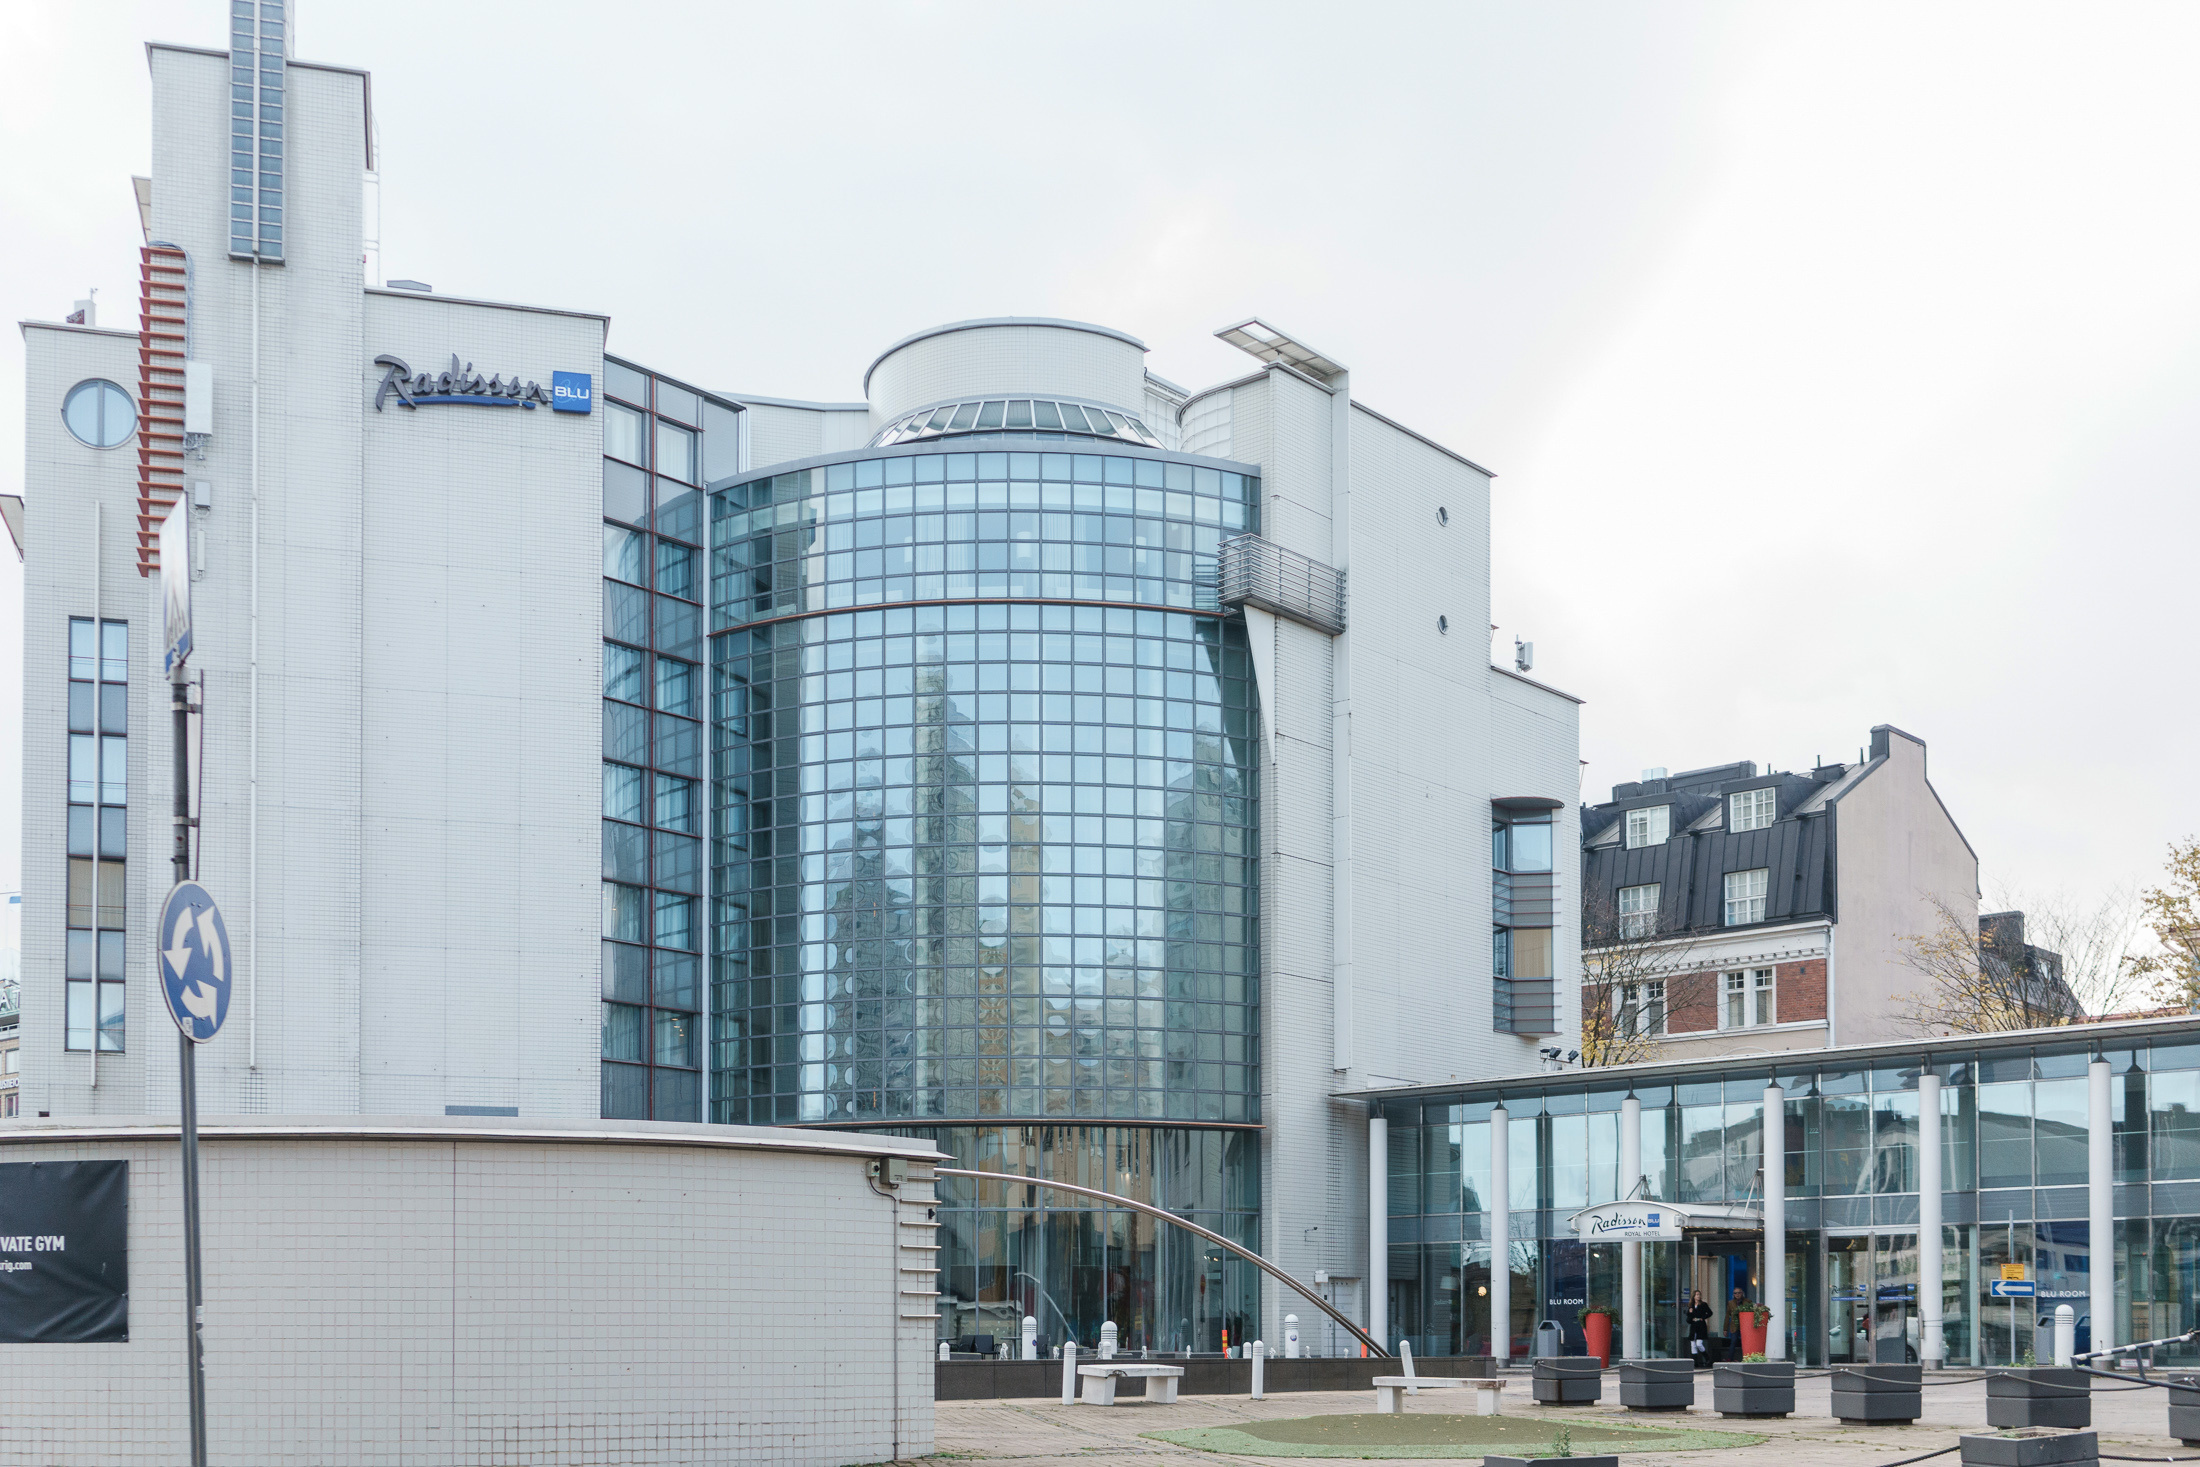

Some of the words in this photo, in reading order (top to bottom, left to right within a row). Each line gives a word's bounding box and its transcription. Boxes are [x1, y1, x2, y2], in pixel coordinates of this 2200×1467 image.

[374, 352, 549, 412] Radisson
[554, 385, 590, 400] BLU
[1591, 1212, 1646, 1235] Radisson
[35, 1235, 65, 1251] GYM
[0, 1259, 33, 1273] rig.com
[2040, 1290, 2057, 1298] BLU
[2059, 1290, 2086, 1298] ROOM
